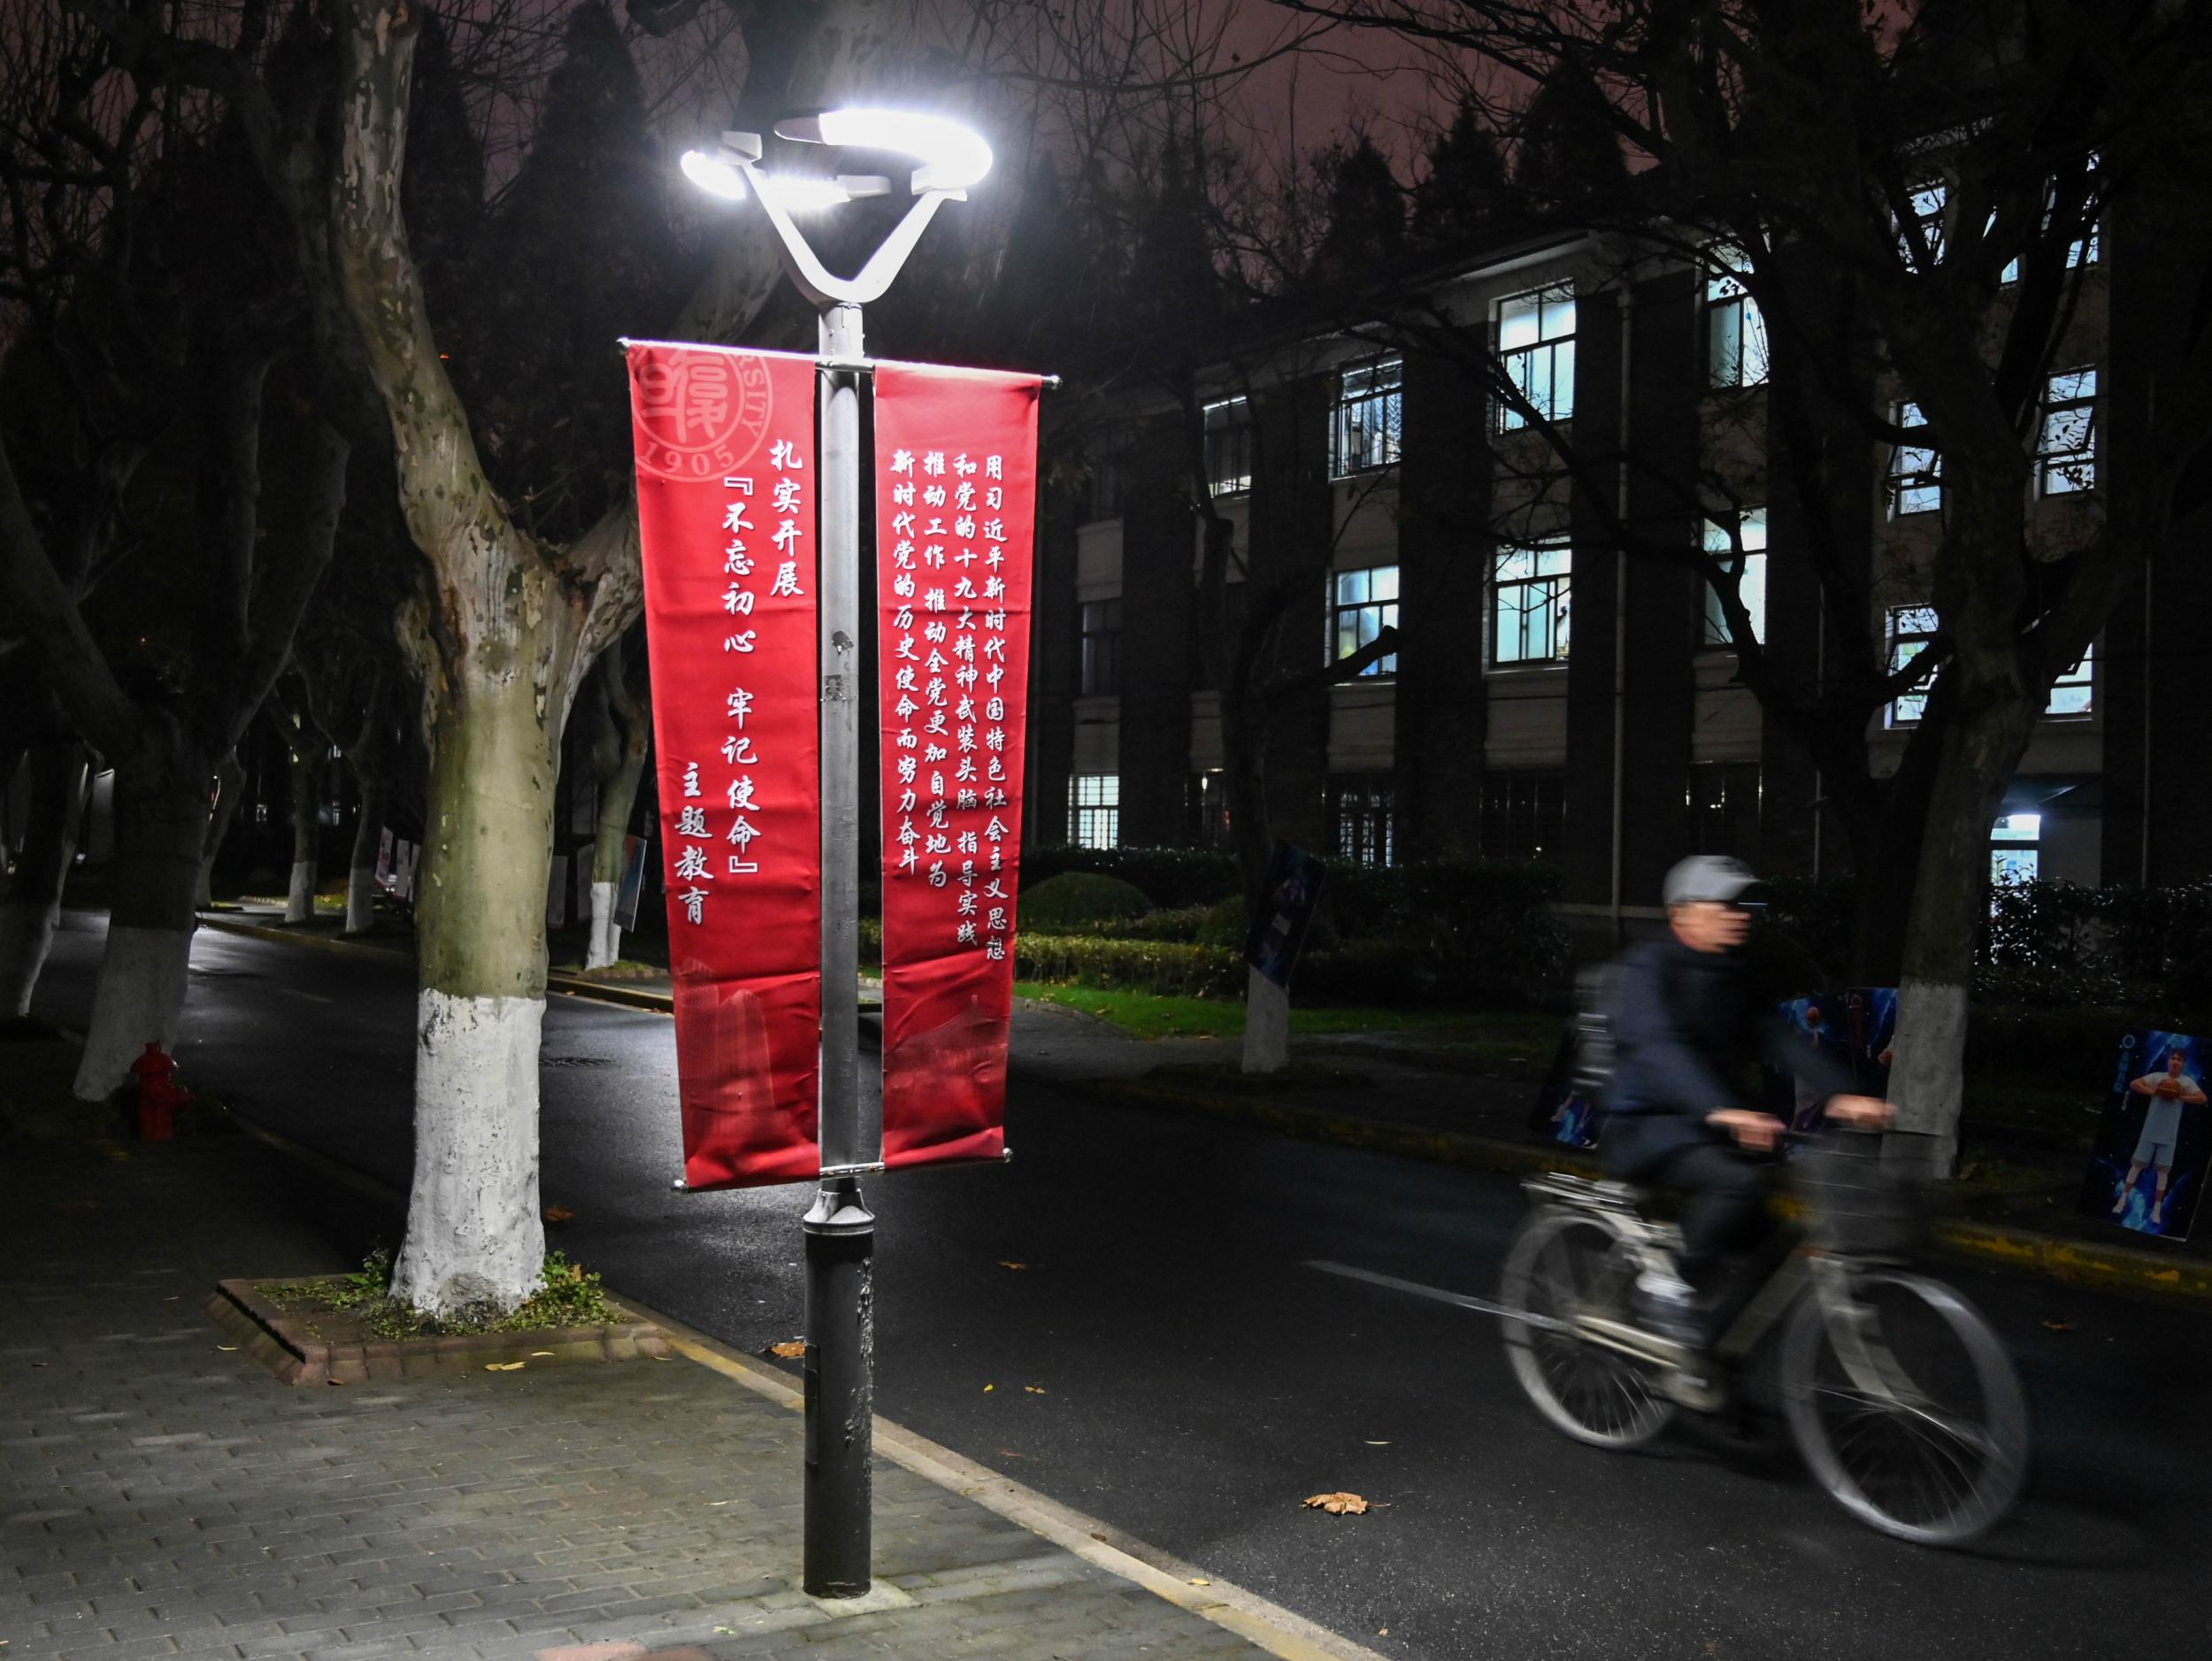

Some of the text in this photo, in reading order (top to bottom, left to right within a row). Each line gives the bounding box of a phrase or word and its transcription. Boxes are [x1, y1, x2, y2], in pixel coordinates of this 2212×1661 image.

[640, 441, 735, 477] 1905
[768, 438, 805, 597] 扎实开展
[888, 448, 921, 876] 新时代党的历史使命而努力奋斗
[922, 450, 953, 888] 推动工作 推动全党更加自觉地为
[674, 761, 715, 926] 主题教育
[952, 452, 979, 948] 和党的十九大精神武装头脑 指导实践
[981, 453, 1010, 961] 用习近平新时代中国特色社会主义思想
